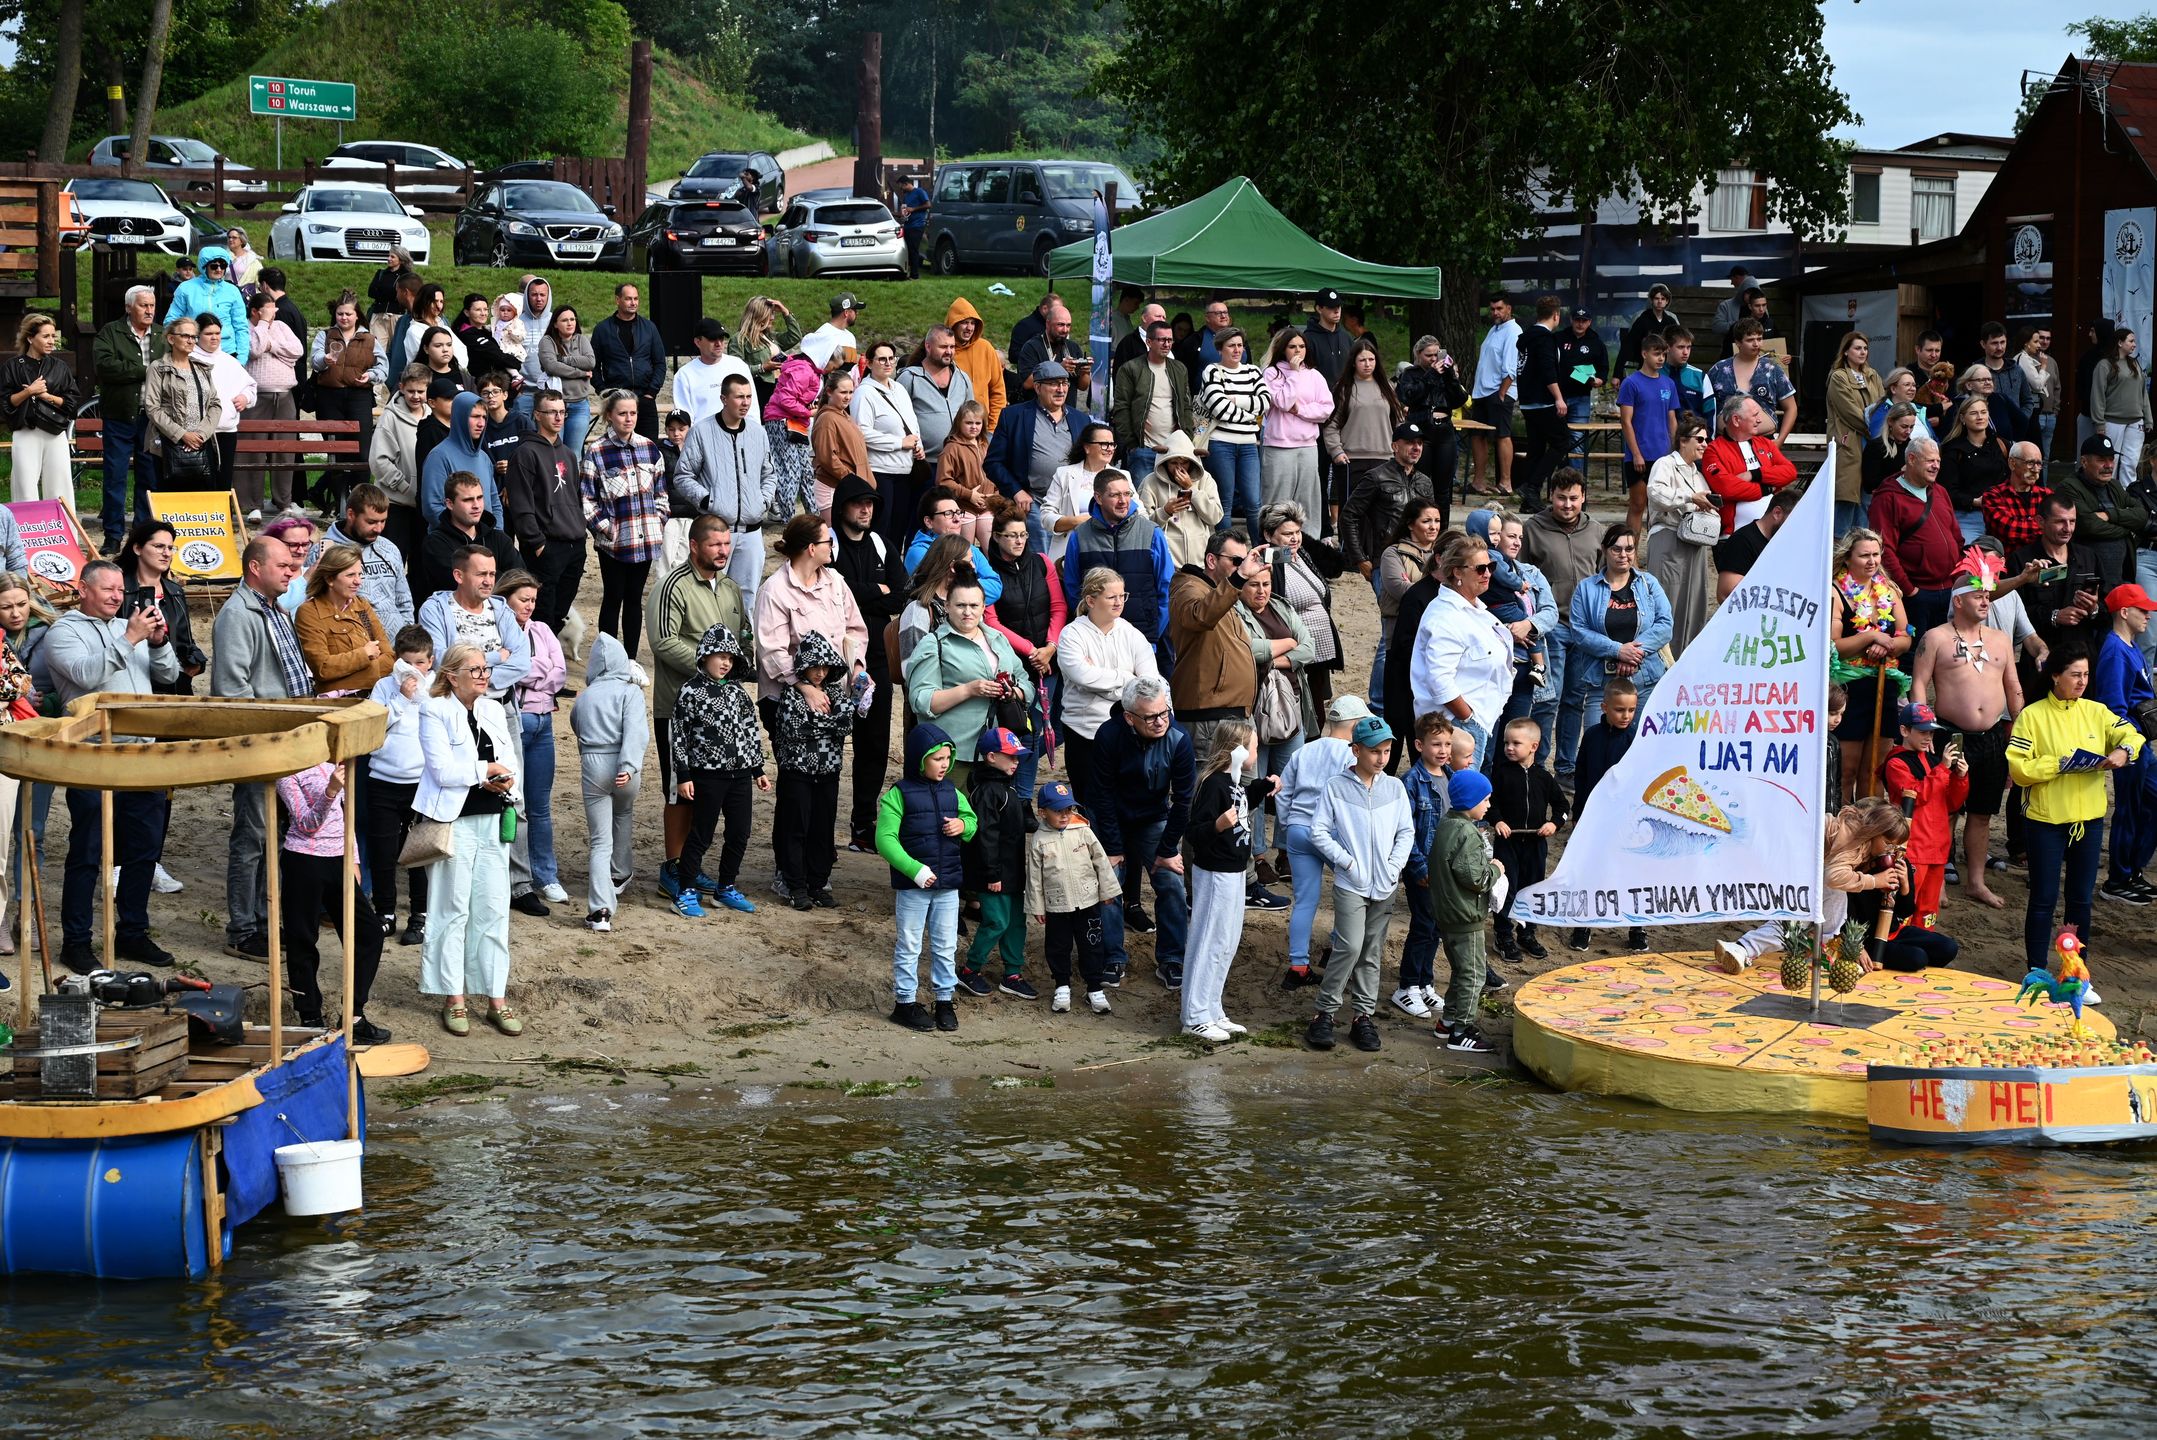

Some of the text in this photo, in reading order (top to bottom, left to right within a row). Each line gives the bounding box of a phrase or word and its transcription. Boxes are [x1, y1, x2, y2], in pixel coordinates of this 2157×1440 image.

[271, 83, 316, 96] 10 Toruń
[271, 99, 339, 113] 10 Warszawa
[488, 435, 519, 448] HEAD
[161, 511, 225, 524] Relaksuj się
[48, 519, 63, 531] się
[175, 527, 226, 537] SYRENKĄ
[1910, 1079, 1948, 1121] HE
